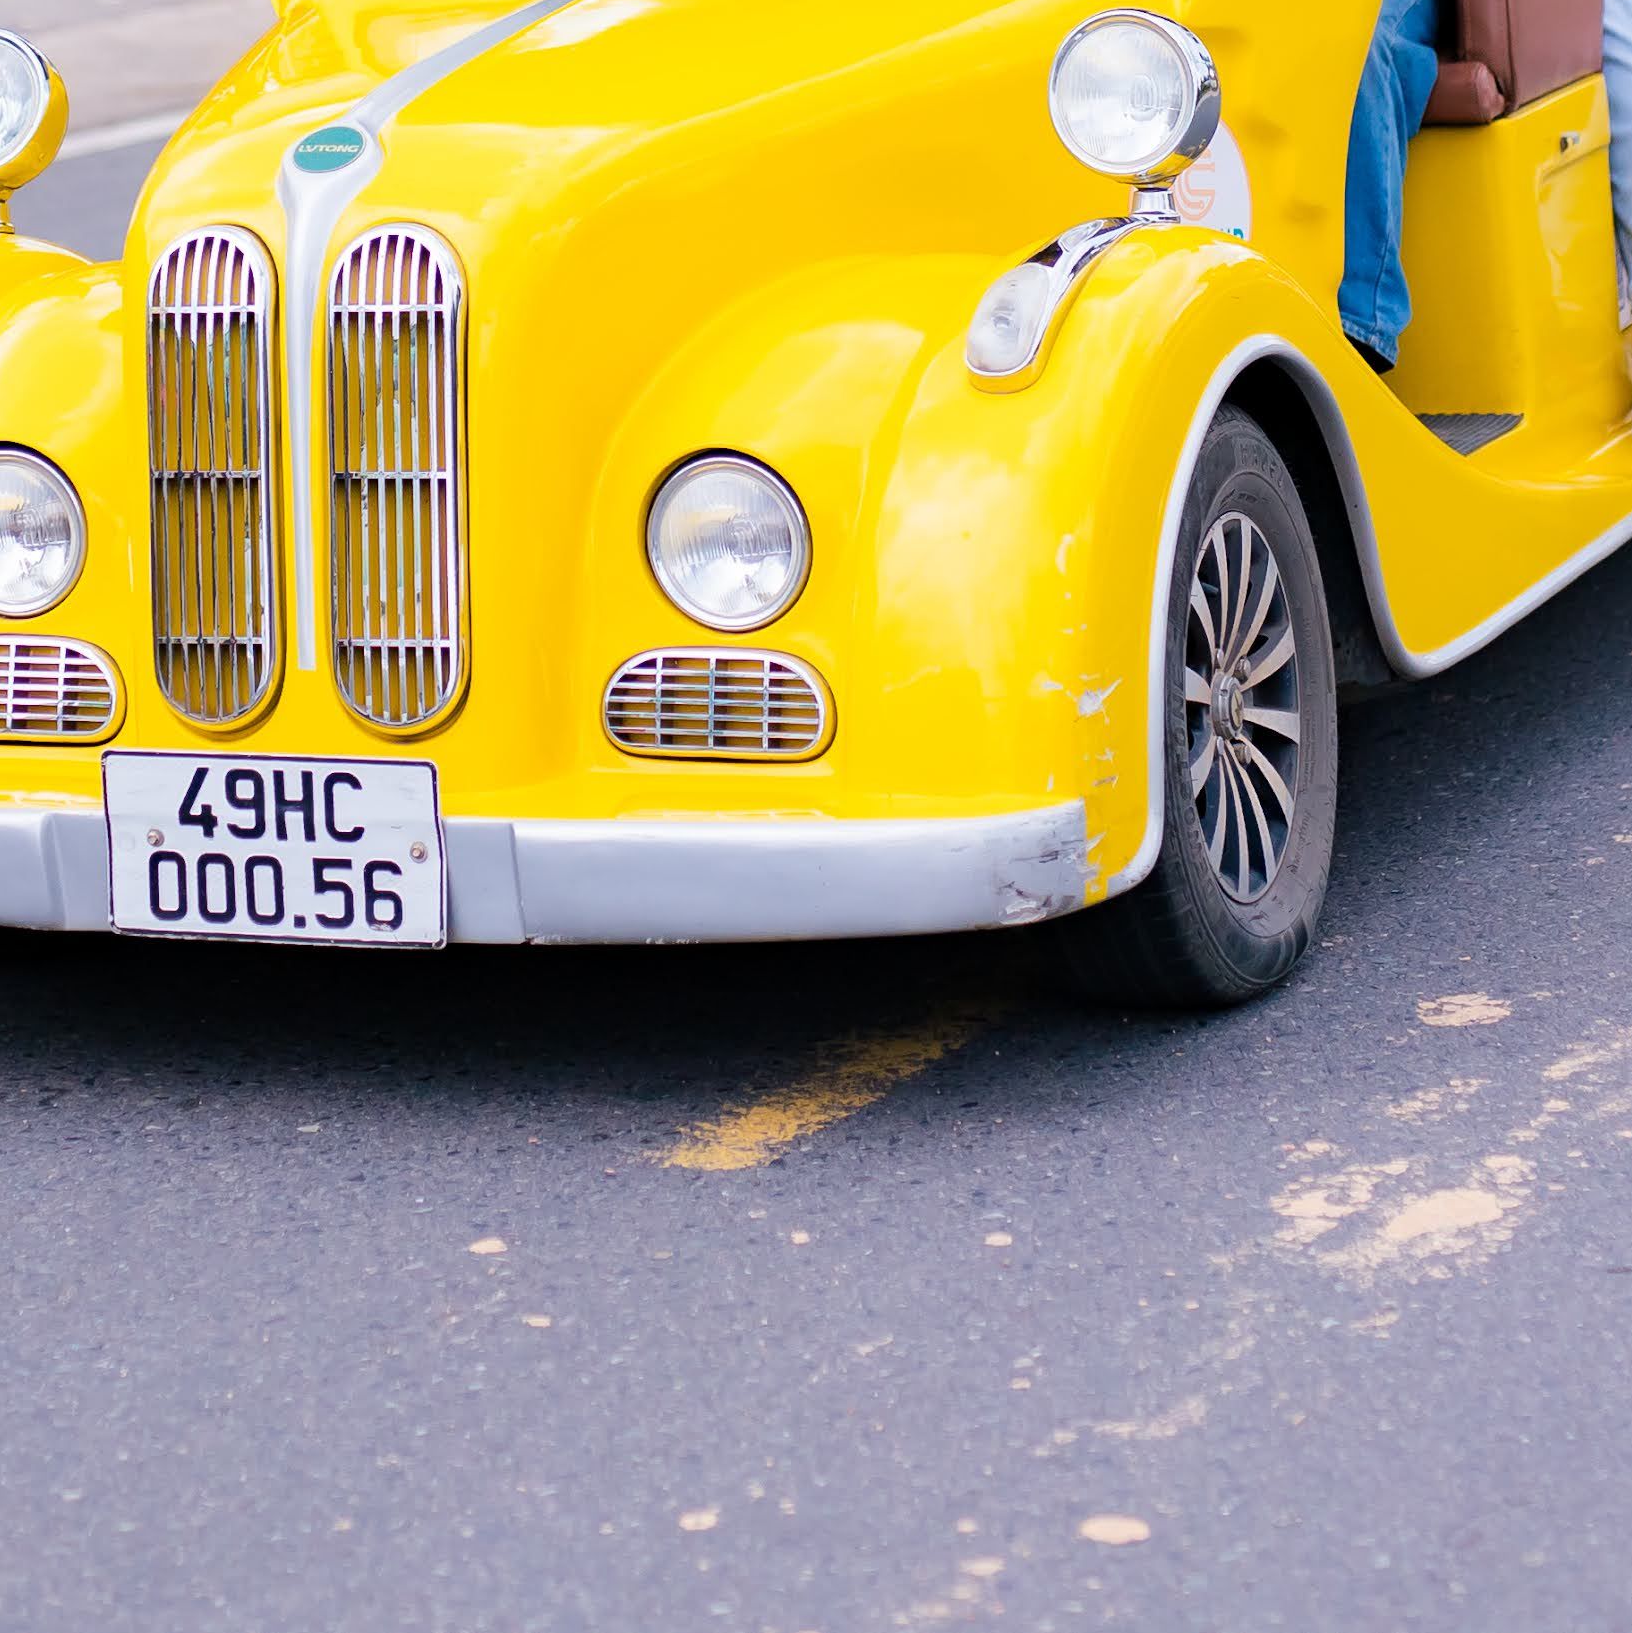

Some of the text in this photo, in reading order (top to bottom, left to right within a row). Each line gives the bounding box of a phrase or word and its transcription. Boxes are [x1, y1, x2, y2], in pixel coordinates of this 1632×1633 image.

[298, 143, 360, 154] LVTONG
[178, 767, 365, 843] 49HC
[148, 850, 403, 932] 000.56
